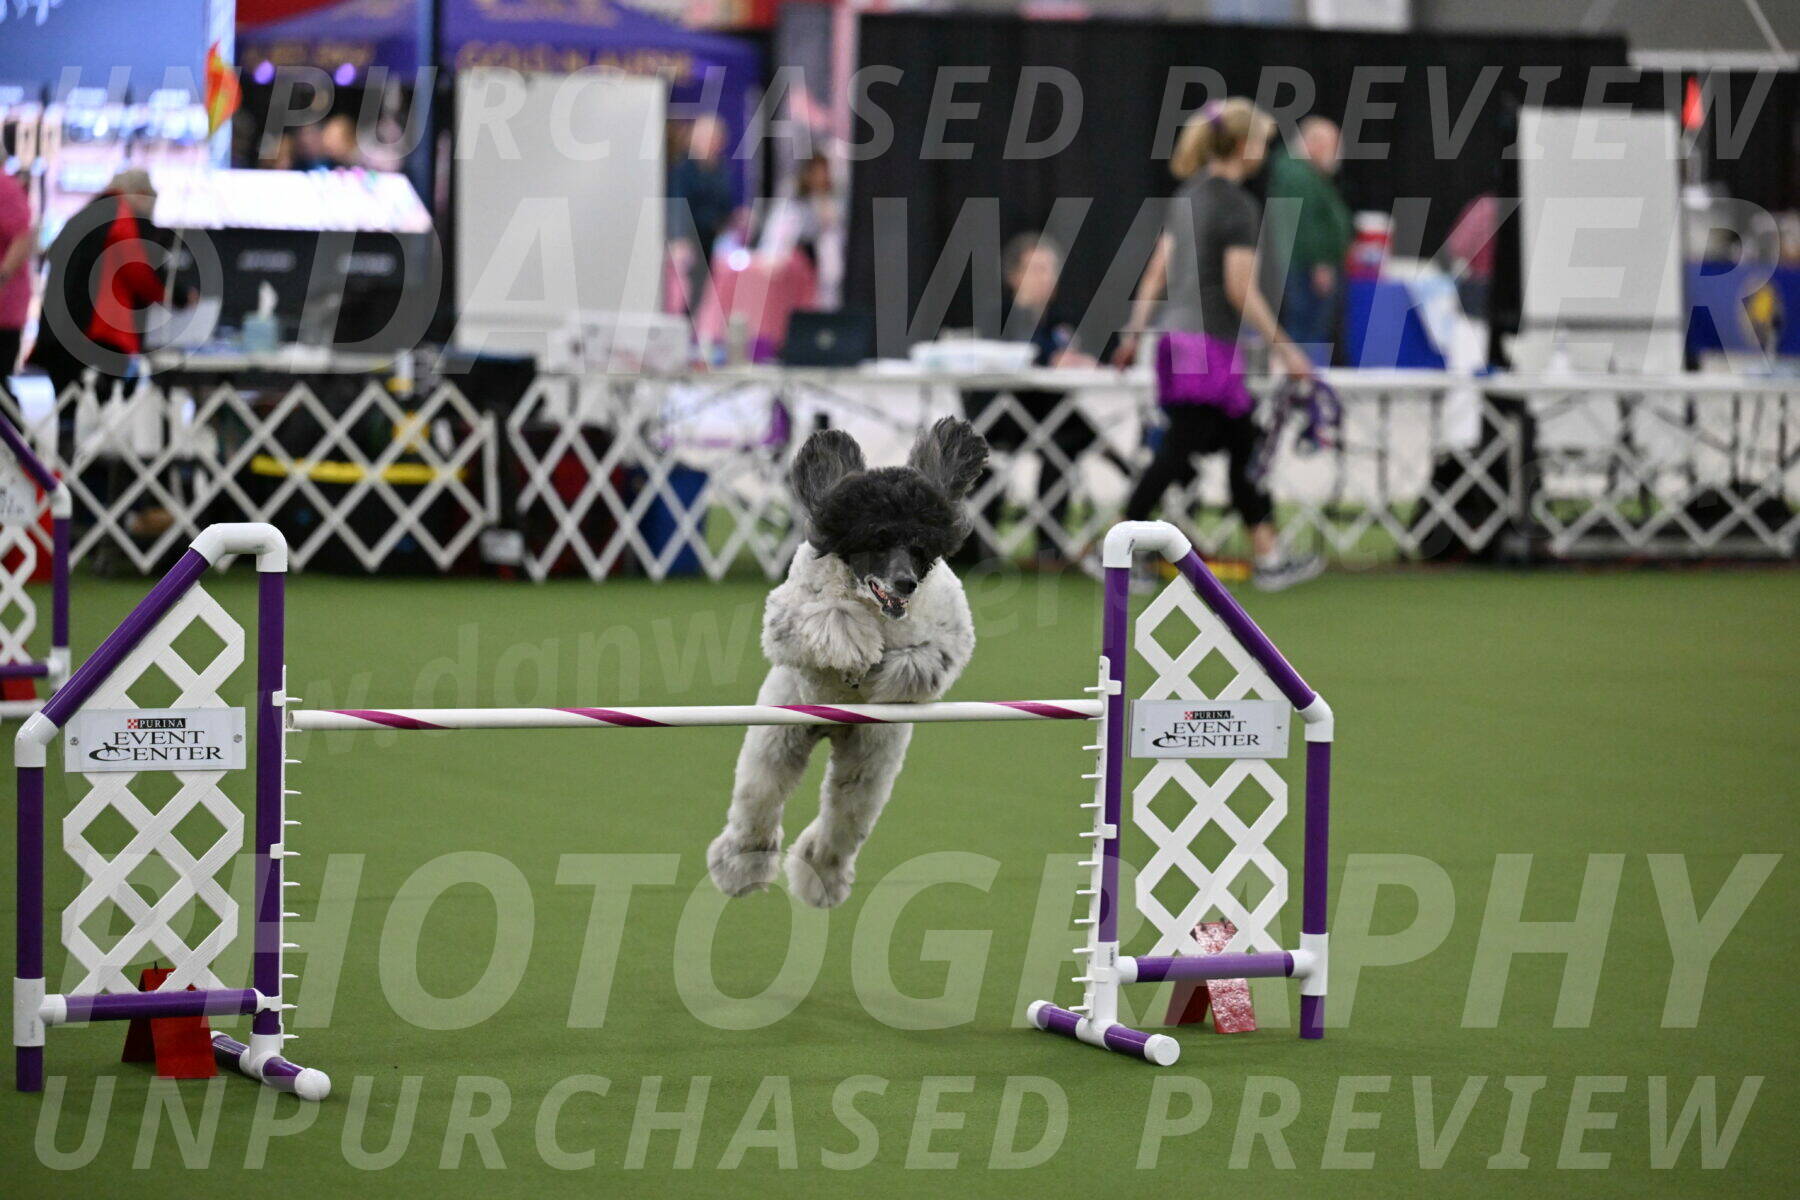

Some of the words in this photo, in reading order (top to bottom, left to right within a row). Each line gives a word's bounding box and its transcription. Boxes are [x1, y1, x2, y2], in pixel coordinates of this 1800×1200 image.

[1194, 711, 1231, 720] PURINA
[139, 718, 185, 729] PURINA
[1172, 720, 1247, 734] EVENT
[114, 730, 205, 746] EVENT
[1152, 734, 1261, 748] CENTER
[88, 745, 224, 762] CENTER
